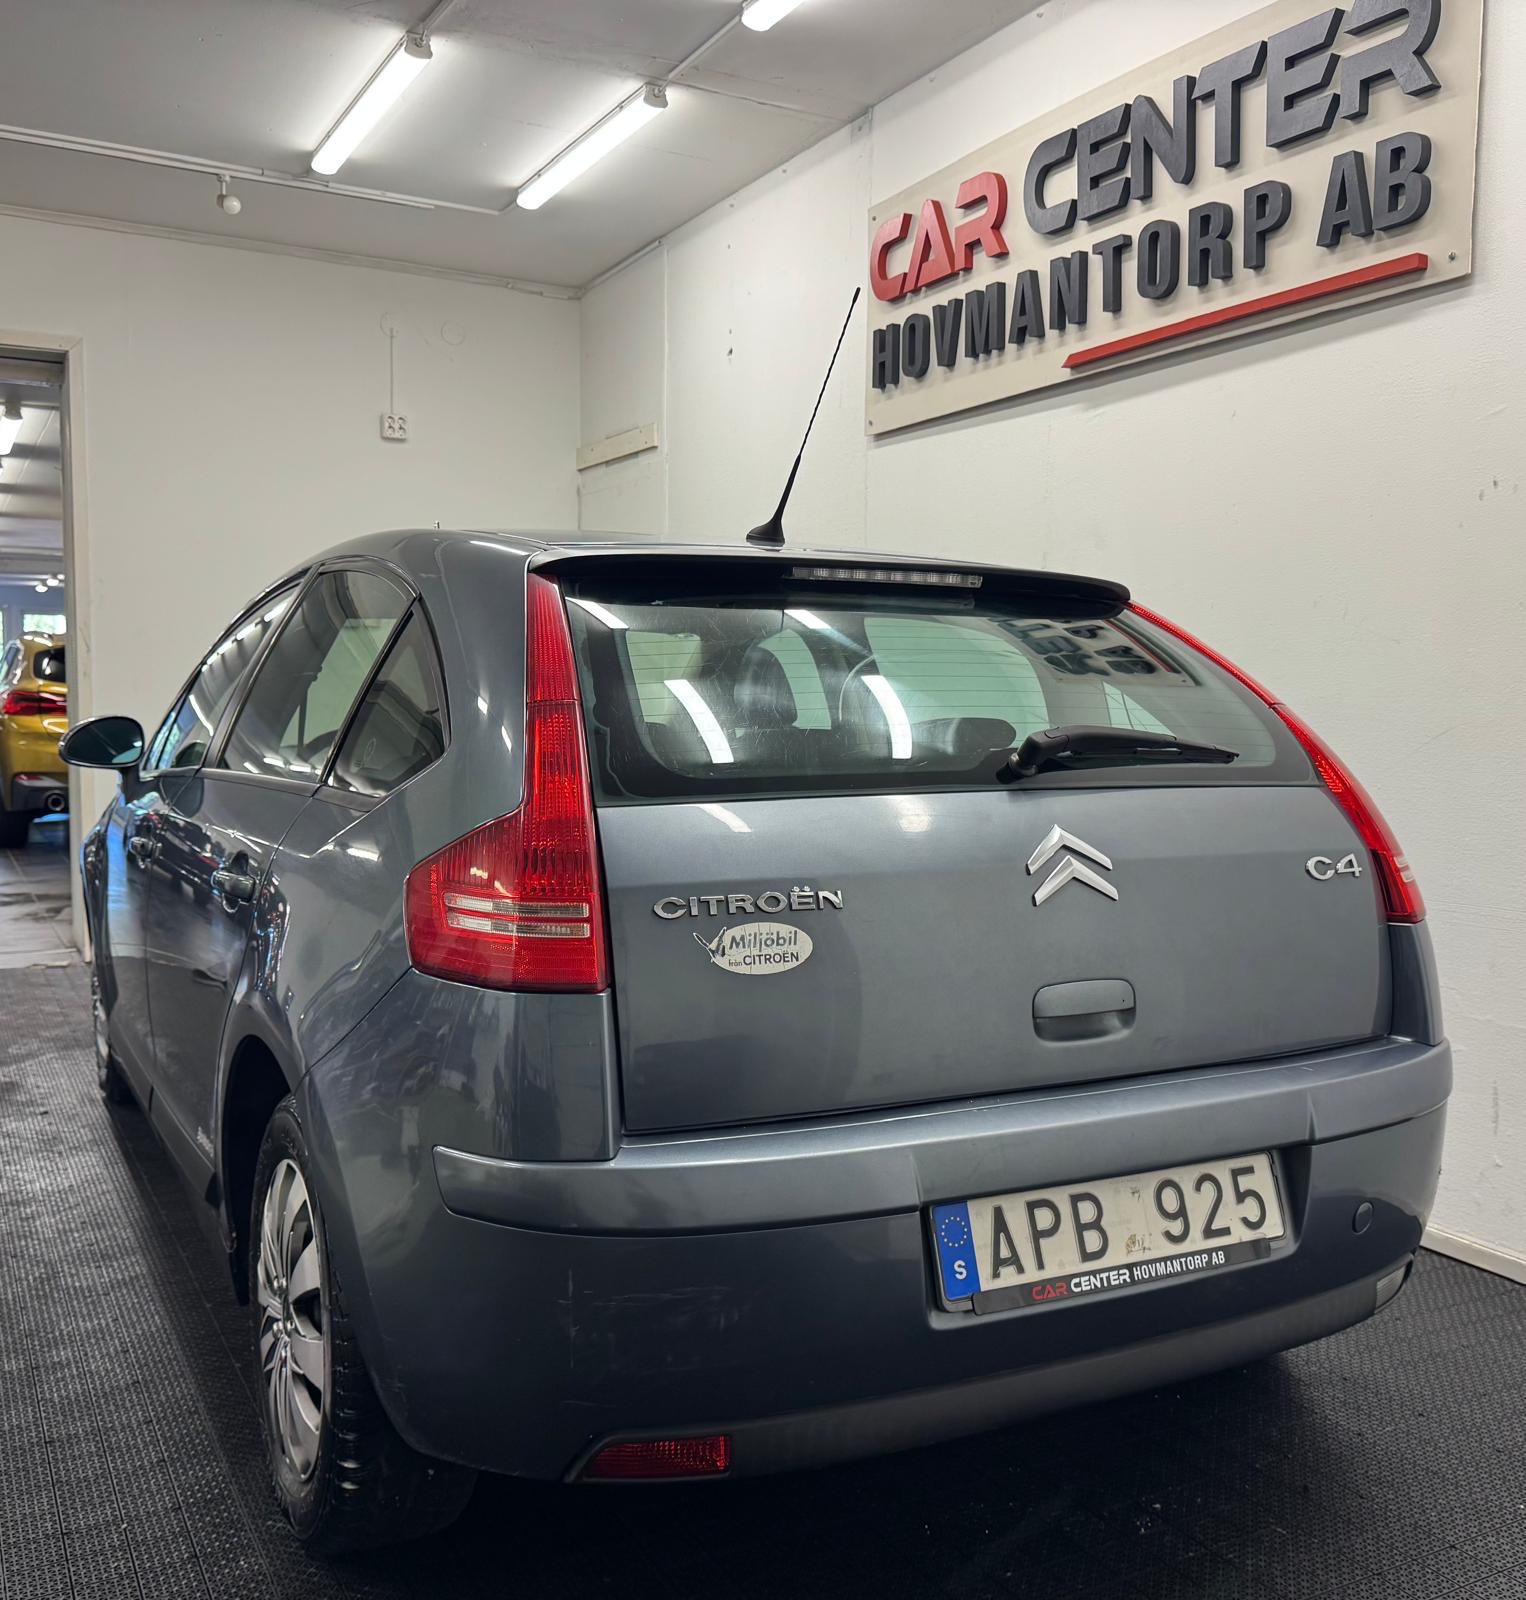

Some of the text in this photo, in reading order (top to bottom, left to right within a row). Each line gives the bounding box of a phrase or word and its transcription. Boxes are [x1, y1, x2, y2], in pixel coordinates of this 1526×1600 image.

[869, 0, 1442, 302] CAR CENTER
[872, 131, 1432, 391] HOVMANTORP AB
[1305, 853, 1362, 881] C4
[653, 885, 844, 920] CITROËN
[729, 930, 798, 953] Miljöbil
[743, 950, 799, 966] CITROËN
[991, 1164, 1267, 1280] APB 925
[953, 1260, 967, 1281] S
[1032, 1250, 1226, 1301] CAR CENTER HOVMANTORP AB
